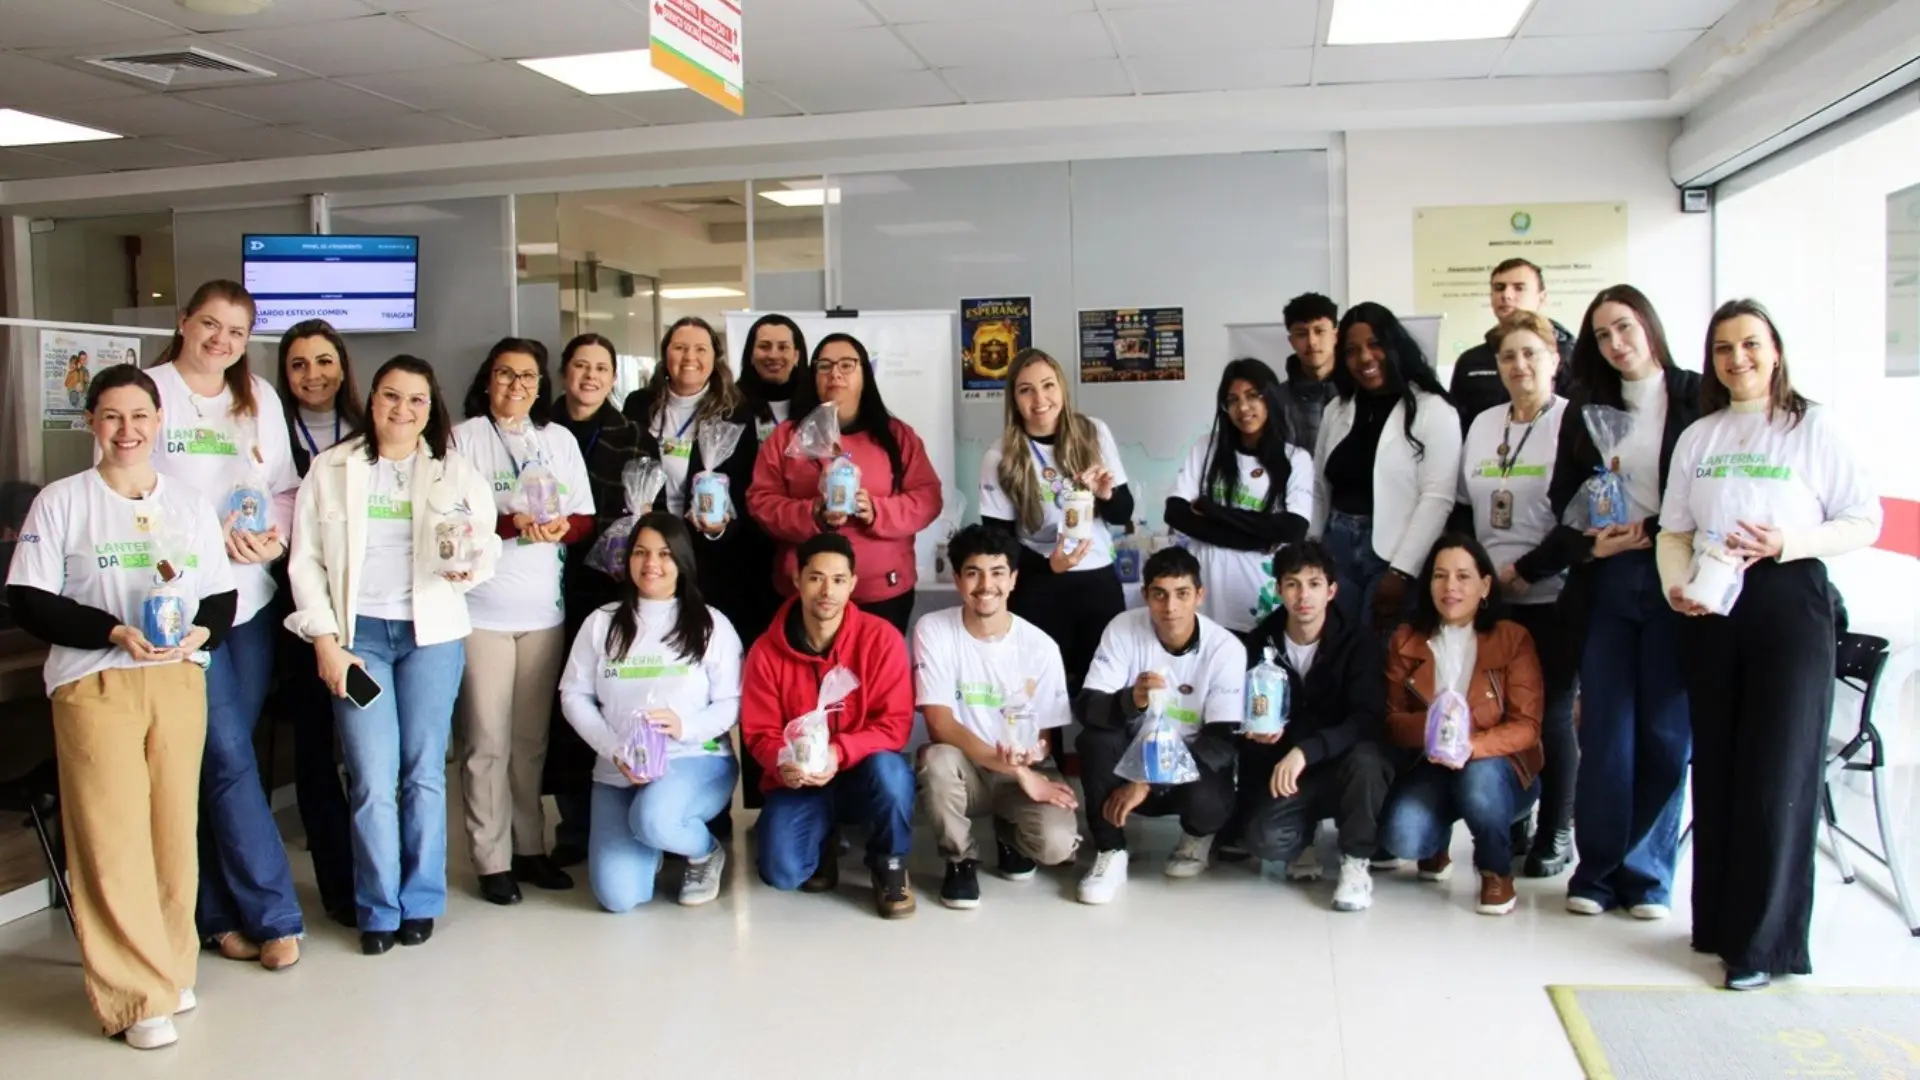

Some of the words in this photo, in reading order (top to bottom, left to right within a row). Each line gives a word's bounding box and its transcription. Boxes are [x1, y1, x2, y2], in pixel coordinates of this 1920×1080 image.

[257, 309, 284, 317] UARDO
[382, 311, 413, 319] TRIAGEM
[167, 441, 186, 453] DA
[1700, 453, 1766, 465] LANTERNA
[1696, 467, 1712, 478] DA
[494, 481, 511, 492] DA
[97, 553, 120, 569] DA
[604, 667, 618, 679] DA
